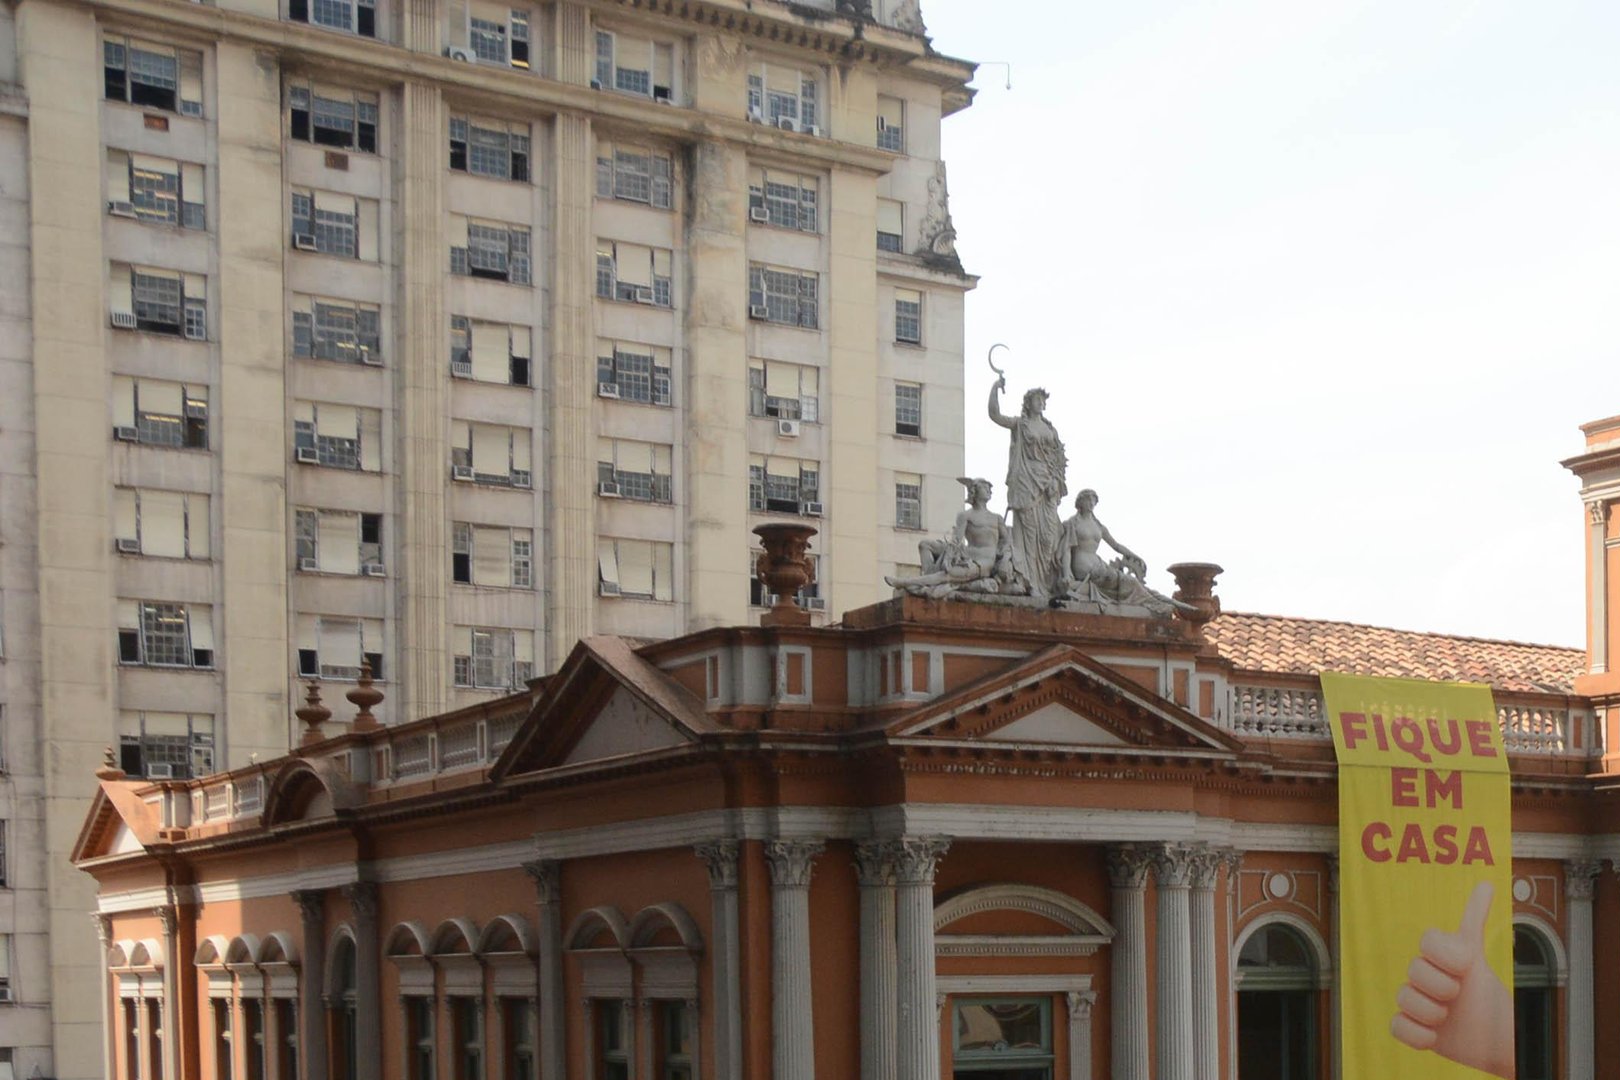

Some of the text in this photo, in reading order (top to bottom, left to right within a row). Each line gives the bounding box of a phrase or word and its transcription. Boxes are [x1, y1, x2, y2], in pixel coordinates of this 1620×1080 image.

[1339, 711, 1498, 763] FIQUE
[1391, 767, 1463, 810] EM
[1360, 821, 1495, 866] CASA
